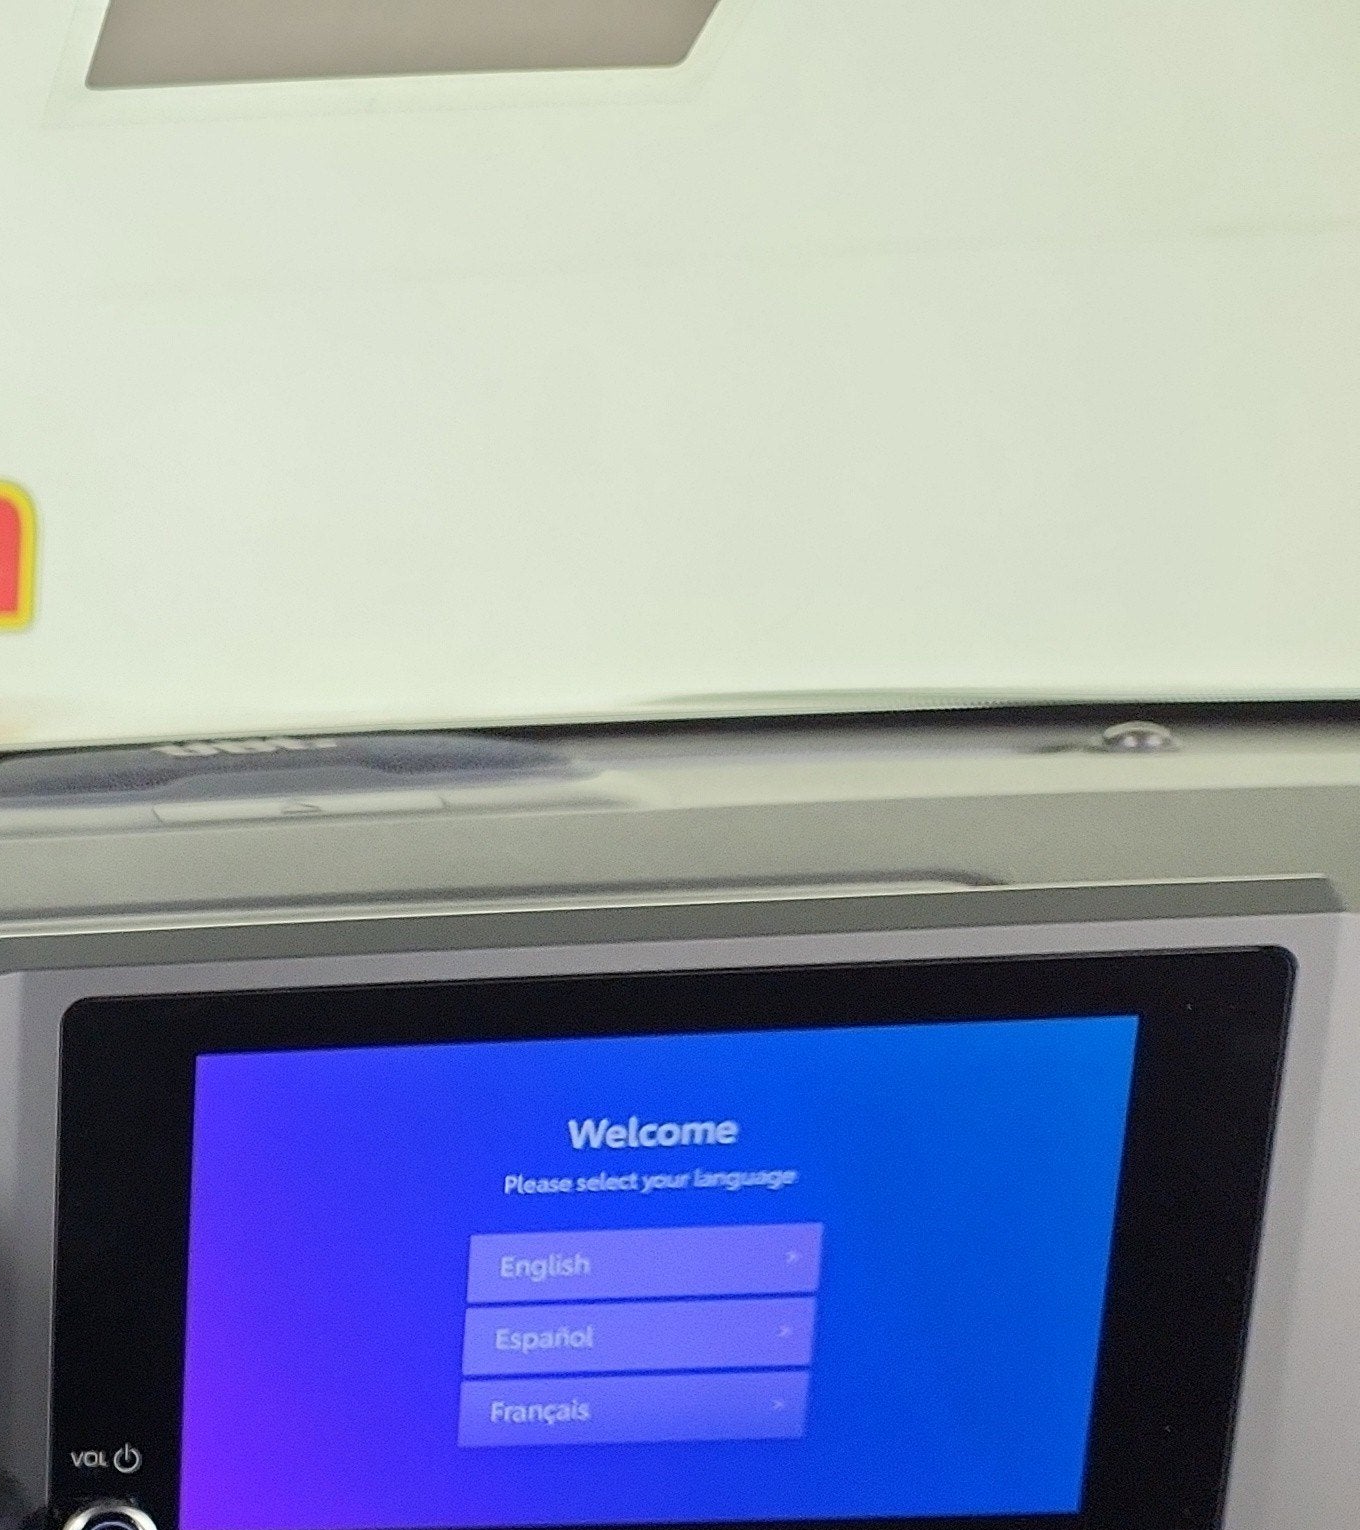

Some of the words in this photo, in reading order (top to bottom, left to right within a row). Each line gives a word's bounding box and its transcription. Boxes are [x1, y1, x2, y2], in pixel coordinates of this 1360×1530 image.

[568, 1116, 739, 1150] Welcome
[504, 1173, 572, 1195] Please
[575, 1171, 638, 1192] select
[641, 1171, 689, 1193] your
[693, 1167, 798, 1190] language
[500, 1251, 591, 1283] English
[494, 1325, 594, 1355] Español
[490, 1399, 590, 1425] Français
[70, 1451, 108, 1468] VOL
